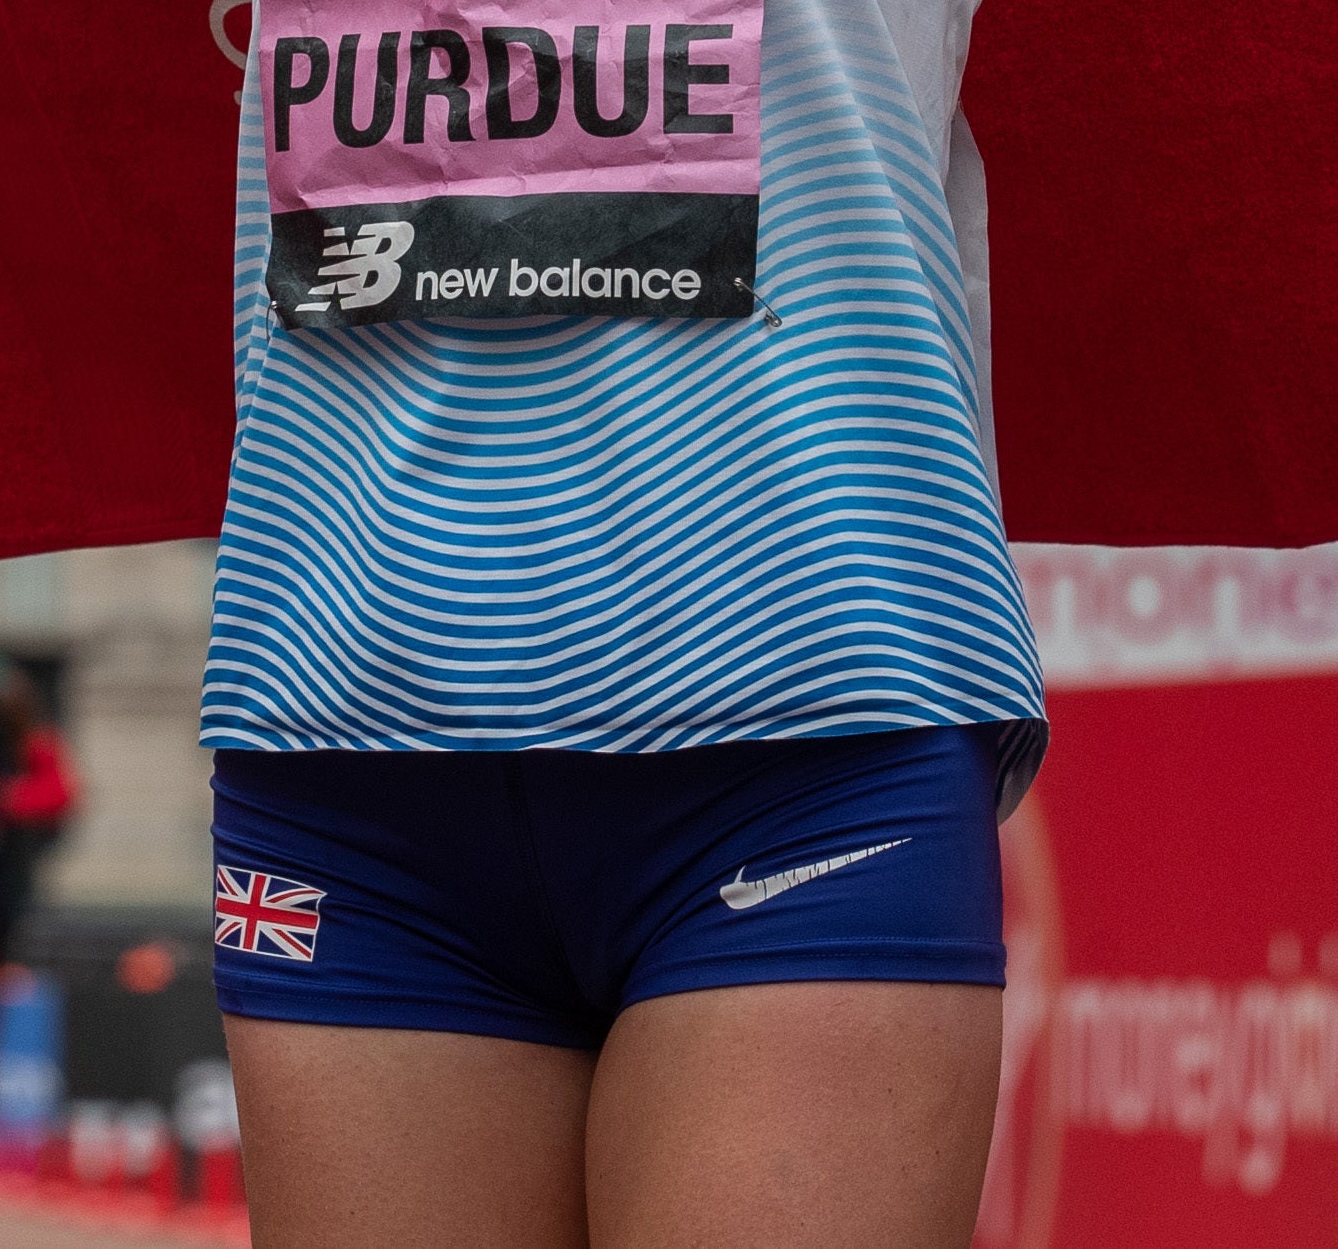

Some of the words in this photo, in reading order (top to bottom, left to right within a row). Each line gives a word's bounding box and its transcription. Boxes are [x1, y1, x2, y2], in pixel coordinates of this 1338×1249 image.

[272, 23, 735, 153] PURDUE
[415, 266, 498, 302] new
[508, 257, 702, 301] balance
